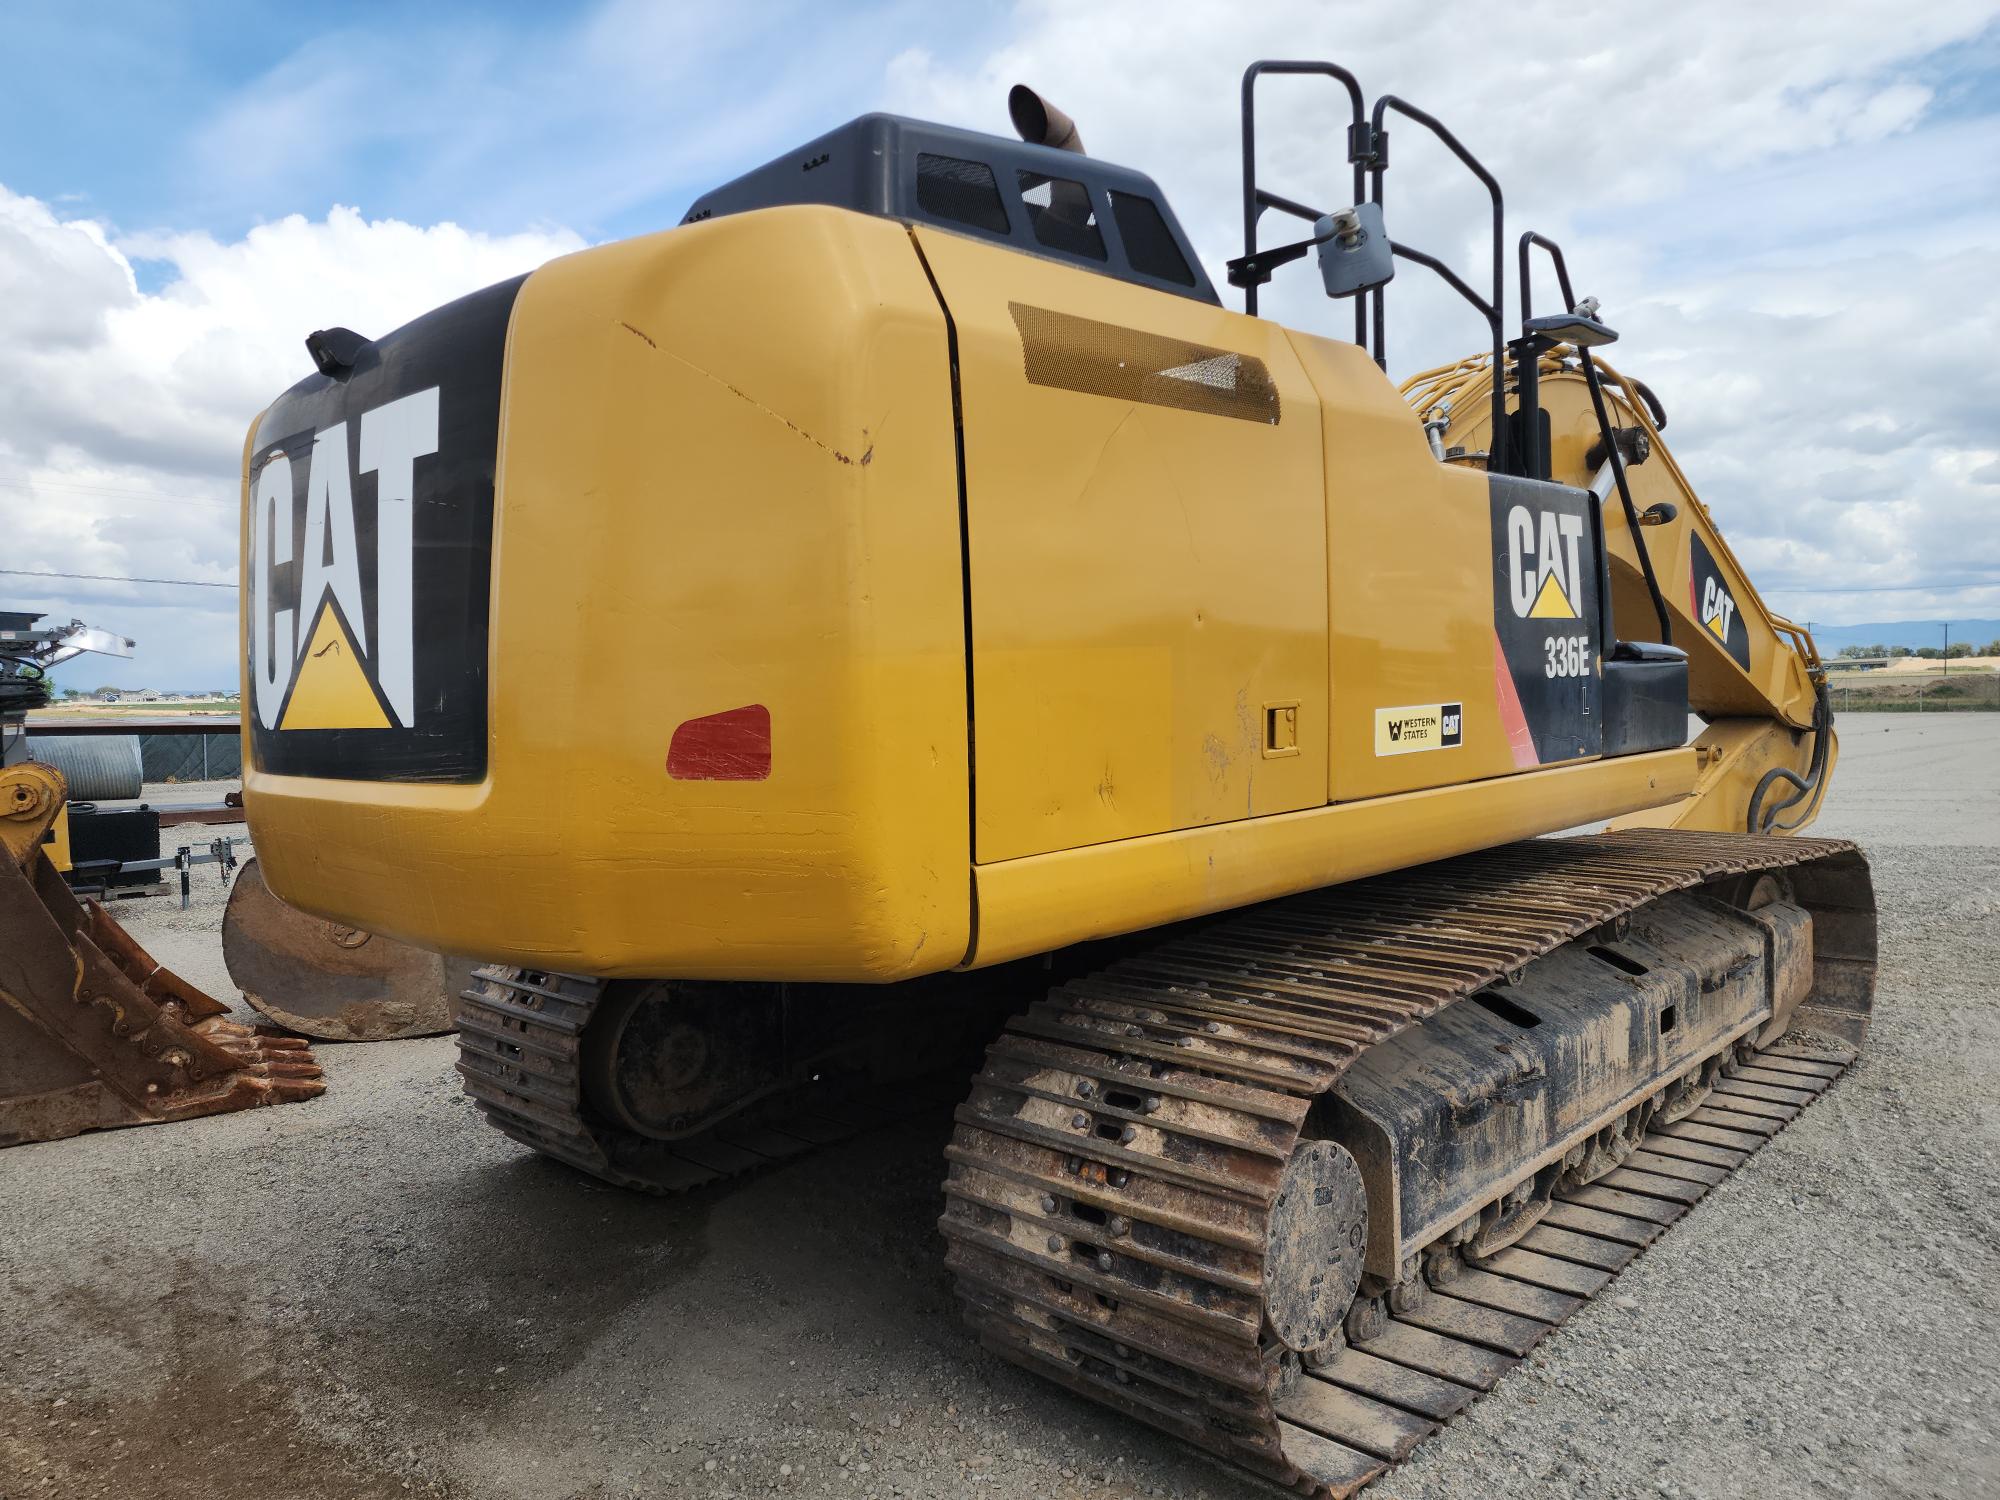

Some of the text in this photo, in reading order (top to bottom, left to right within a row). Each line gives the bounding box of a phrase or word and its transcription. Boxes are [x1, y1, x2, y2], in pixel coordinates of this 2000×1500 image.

[254, 385, 440, 731] CAT
[1508, 505, 1583, 618] CAT
[1702, 576, 1734, 644] CAT
[1544, 636, 1590, 678] 336E
[1404, 717, 1436, 728] WESTERN
[1404, 729, 1428, 740] STATES
[1443, 715, 1460, 735] CAT
